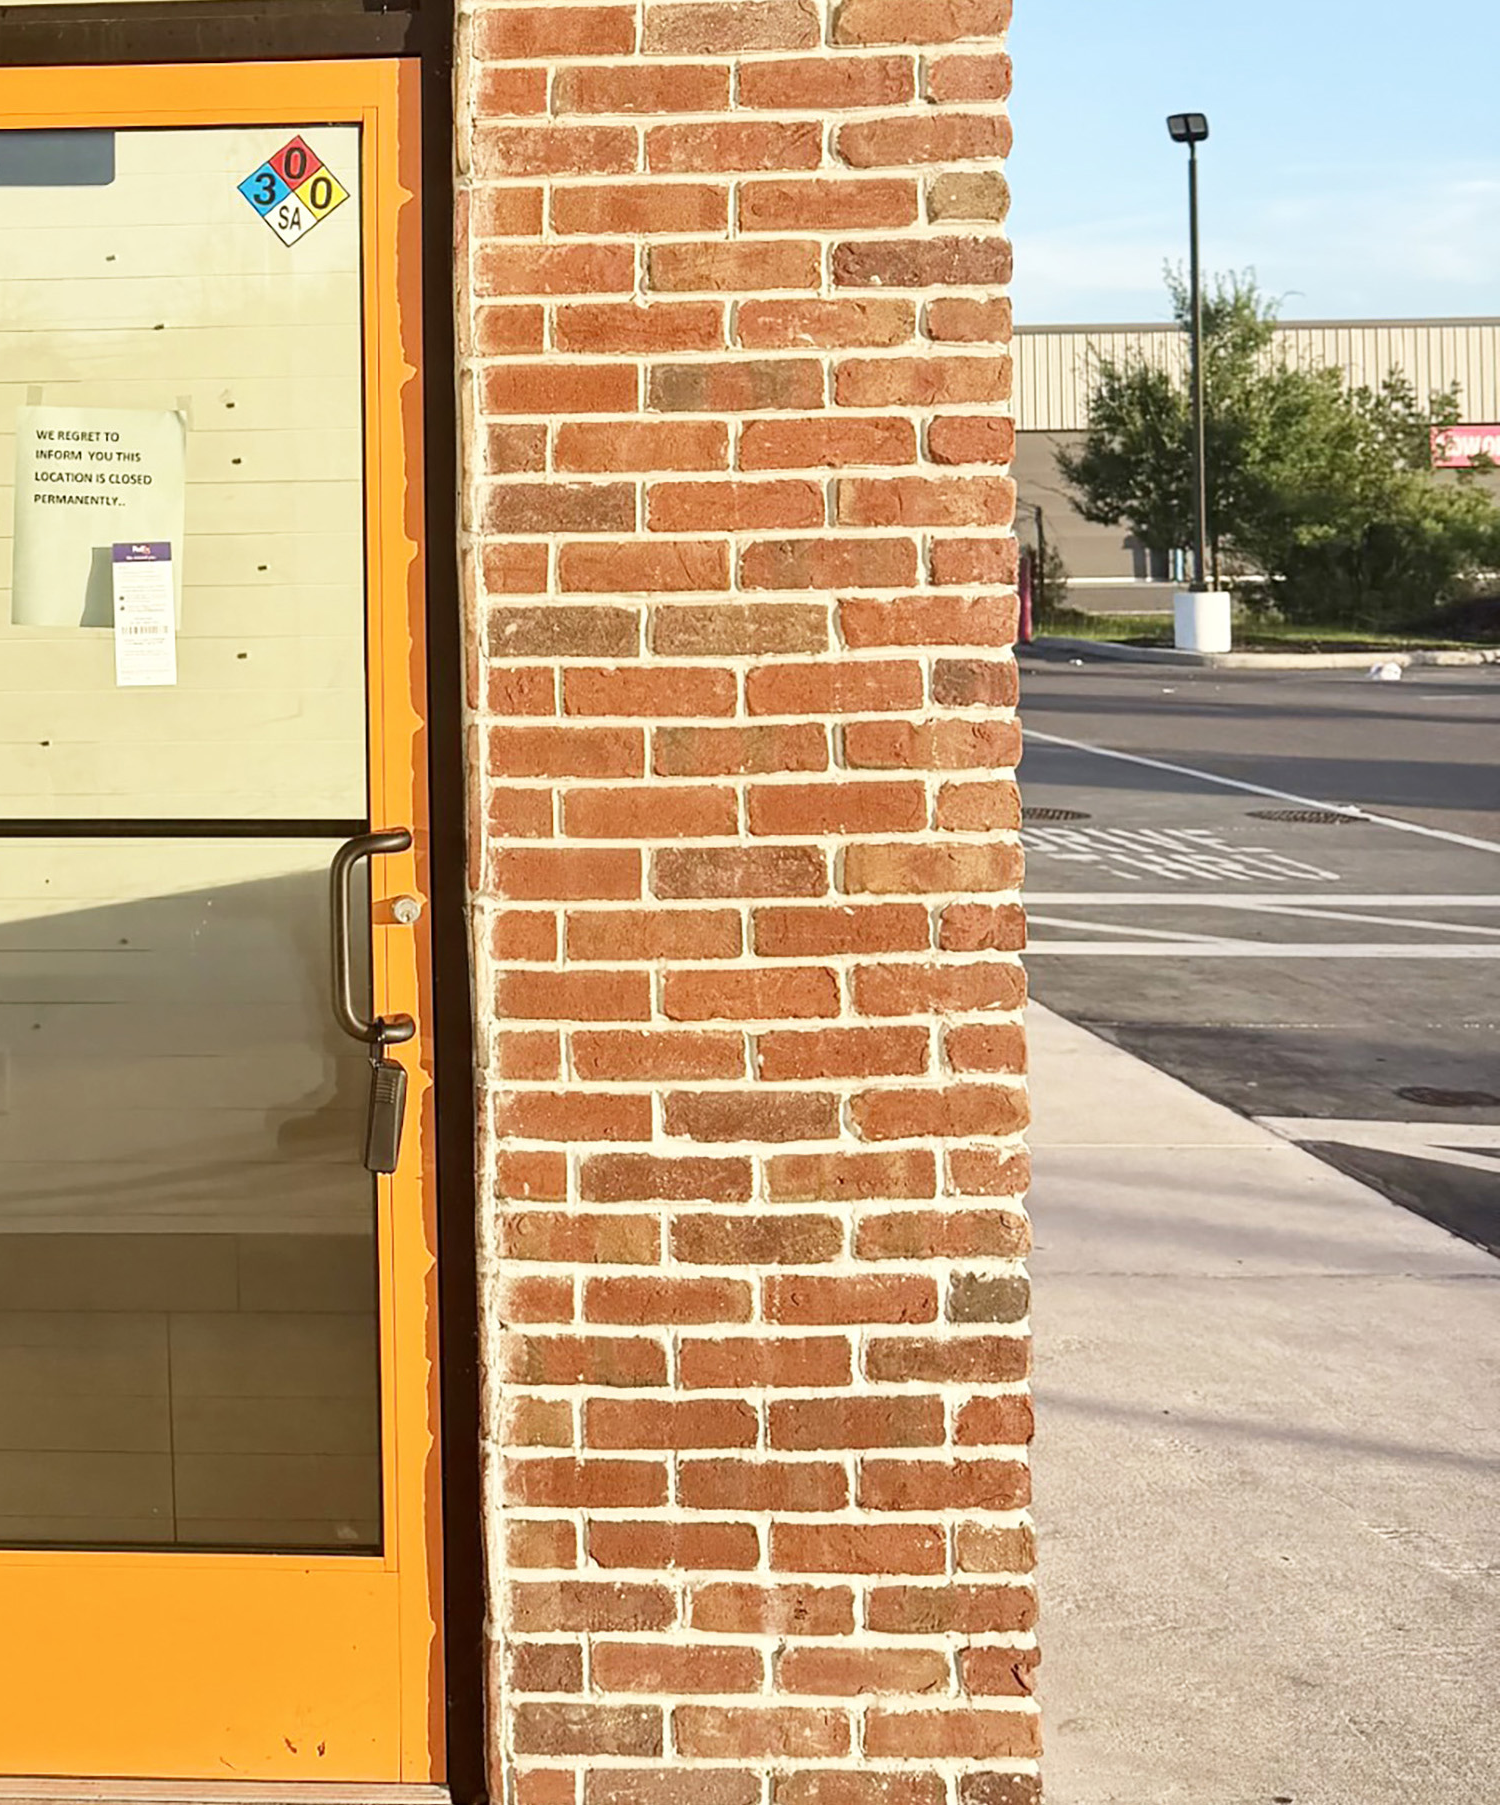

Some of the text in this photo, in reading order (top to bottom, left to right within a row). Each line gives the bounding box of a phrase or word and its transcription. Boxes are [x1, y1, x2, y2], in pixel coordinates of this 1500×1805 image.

[284, 147, 307, 179] 0
[253, 172, 276, 206] 3
[310, 176, 332, 210] 0
[278, 205, 302, 230] SA
[36, 430, 120, 442] WE REGRET TO
[35, 449, 142, 462] INFORM YOU THIS
[34, 471, 152, 485] LOCATION IS CLOSED
[1047, 853, 1341, 881] THRU
